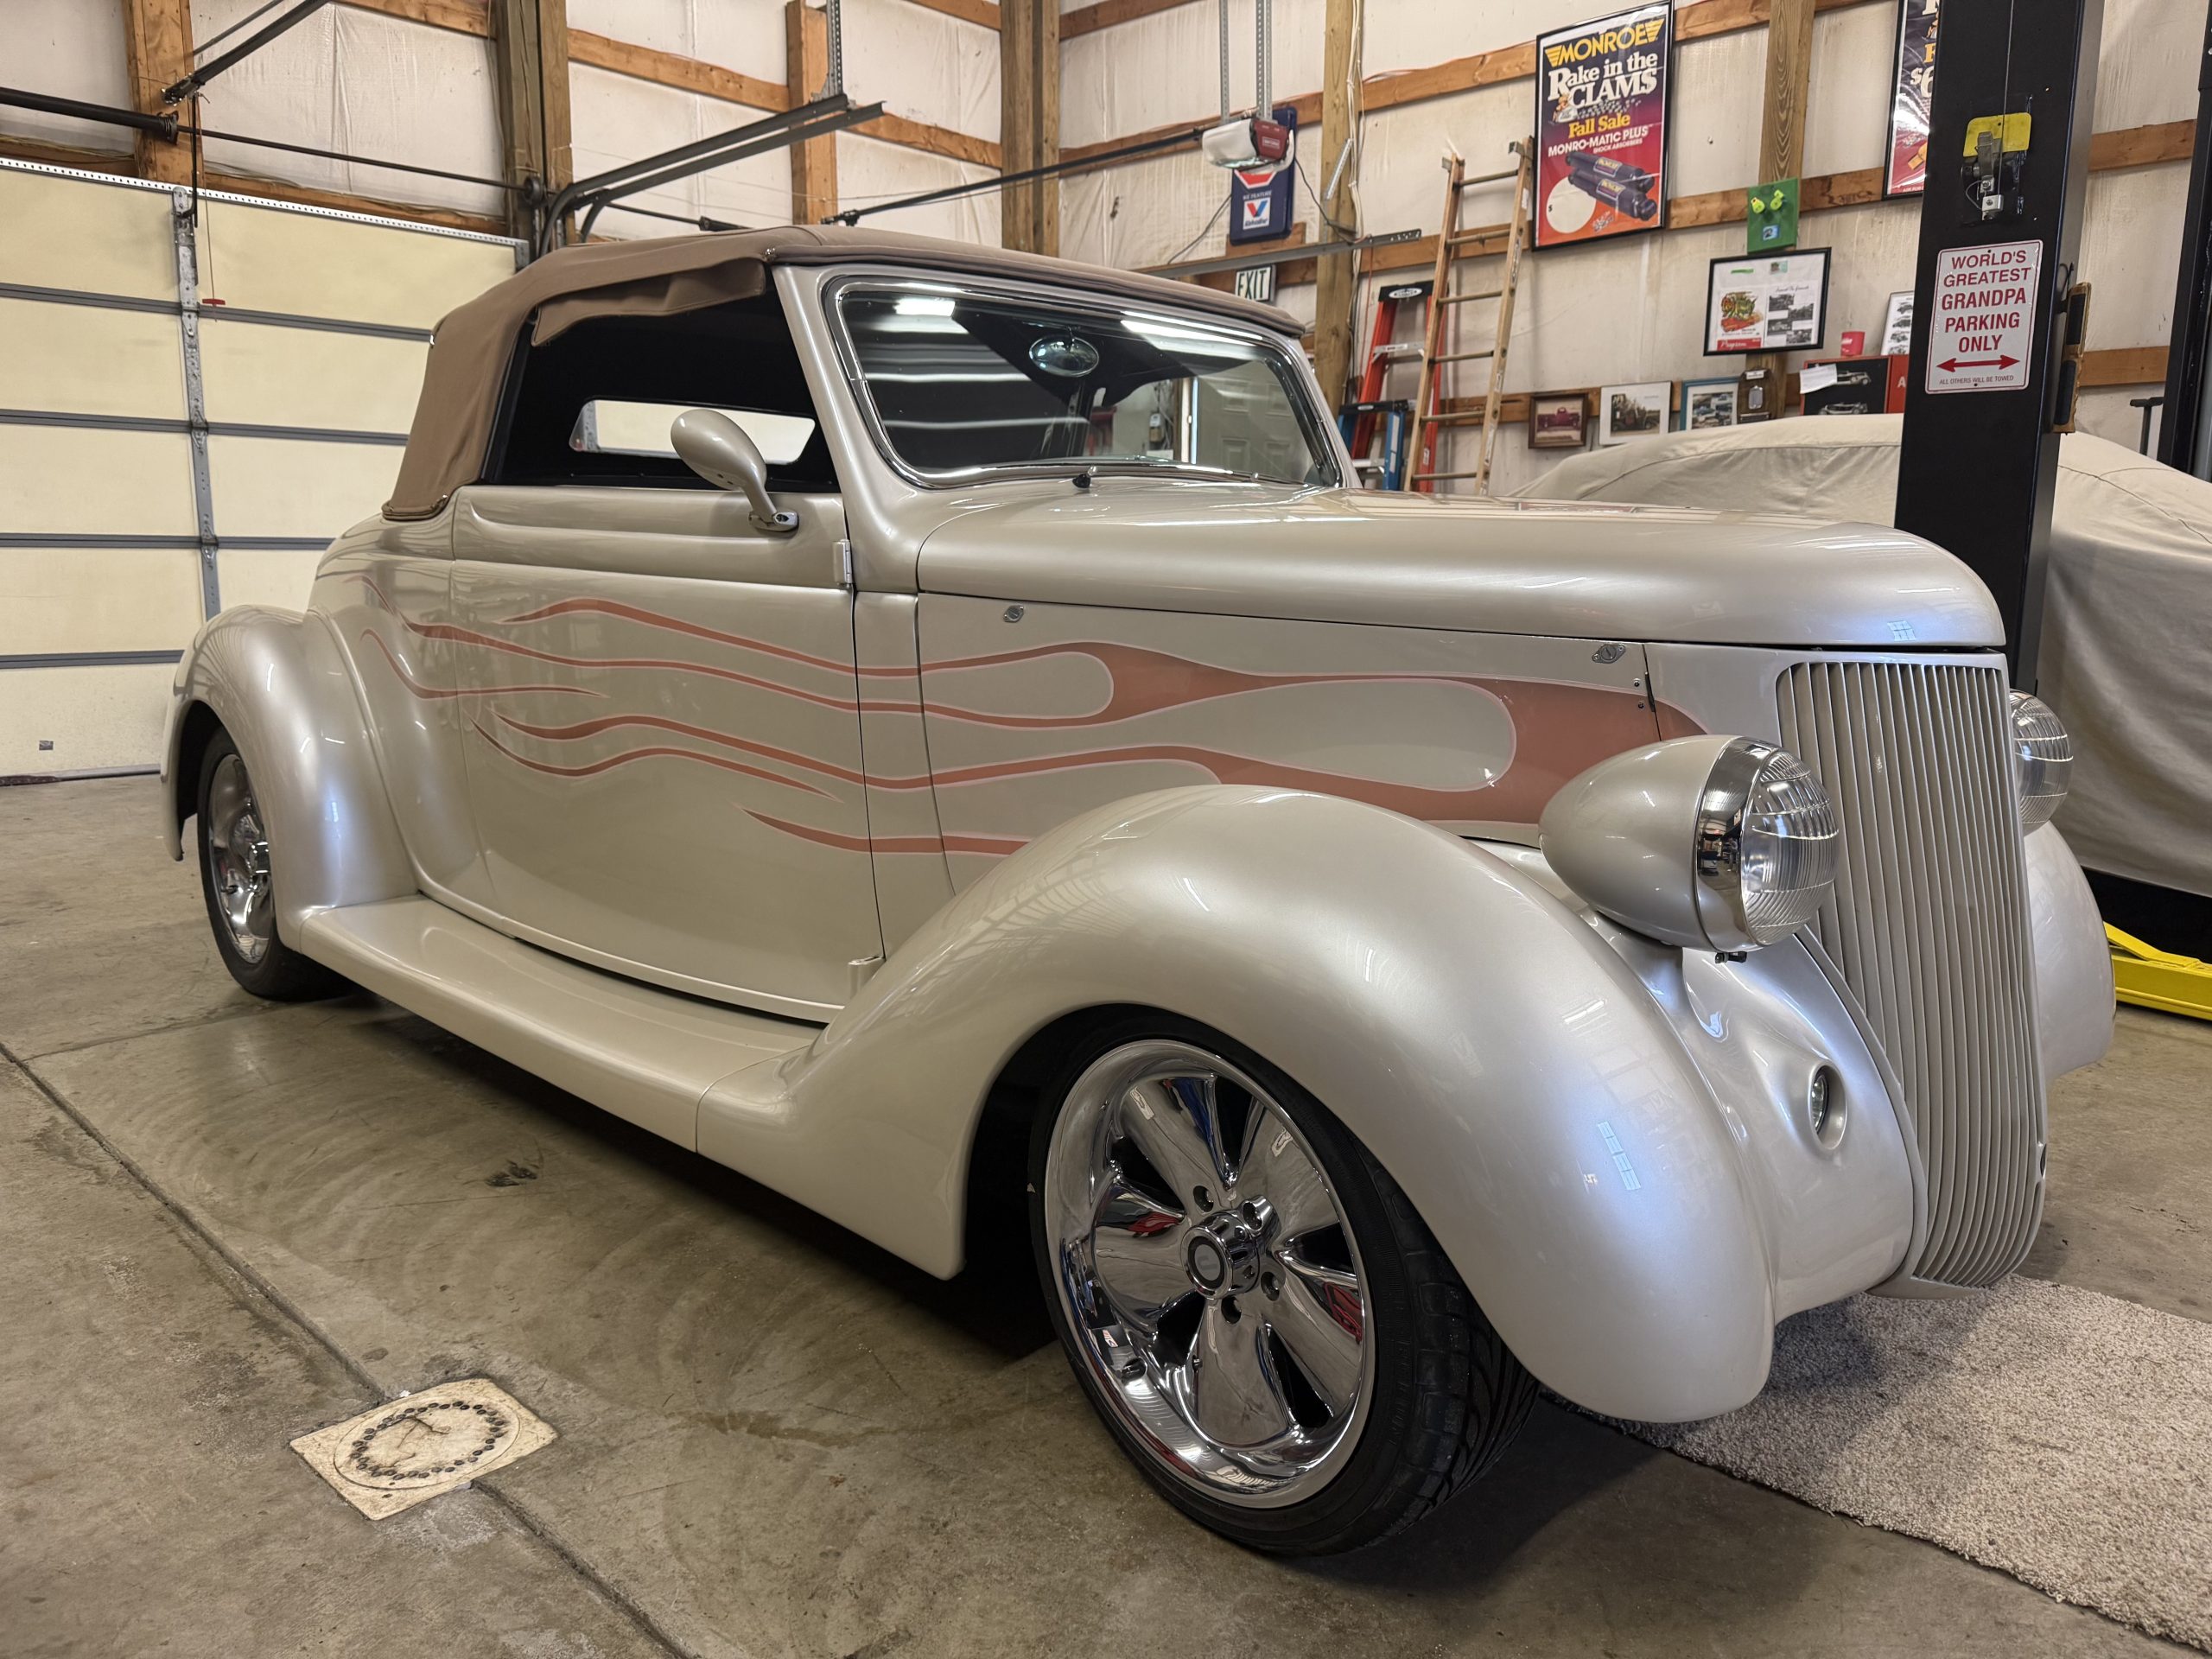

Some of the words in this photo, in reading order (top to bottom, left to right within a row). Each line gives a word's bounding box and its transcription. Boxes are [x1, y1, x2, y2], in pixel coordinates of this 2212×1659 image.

[1558, 23, 1649, 67] MONROE
[1548, 65, 1600, 101] Rake
[1603, 58, 1624, 79] in
[1626, 51, 1658, 72] the
[1568, 117, 1595, 139] Fall
[1598, 111, 1631, 132] Sale
[1548, 131, 1622, 157] MONRO-MATIC
[1622, 125, 1649, 141] PLUS
[1951, 250, 2026, 270] WORLD'S
[1237, 270, 1268, 300] EXIT
[1943, 267, 2031, 288] GREATEST
[1941, 287, 2027, 311] GRANDPA
[1944, 312, 2020, 334] PARKING
[1958, 334, 2003, 353] ONLY
